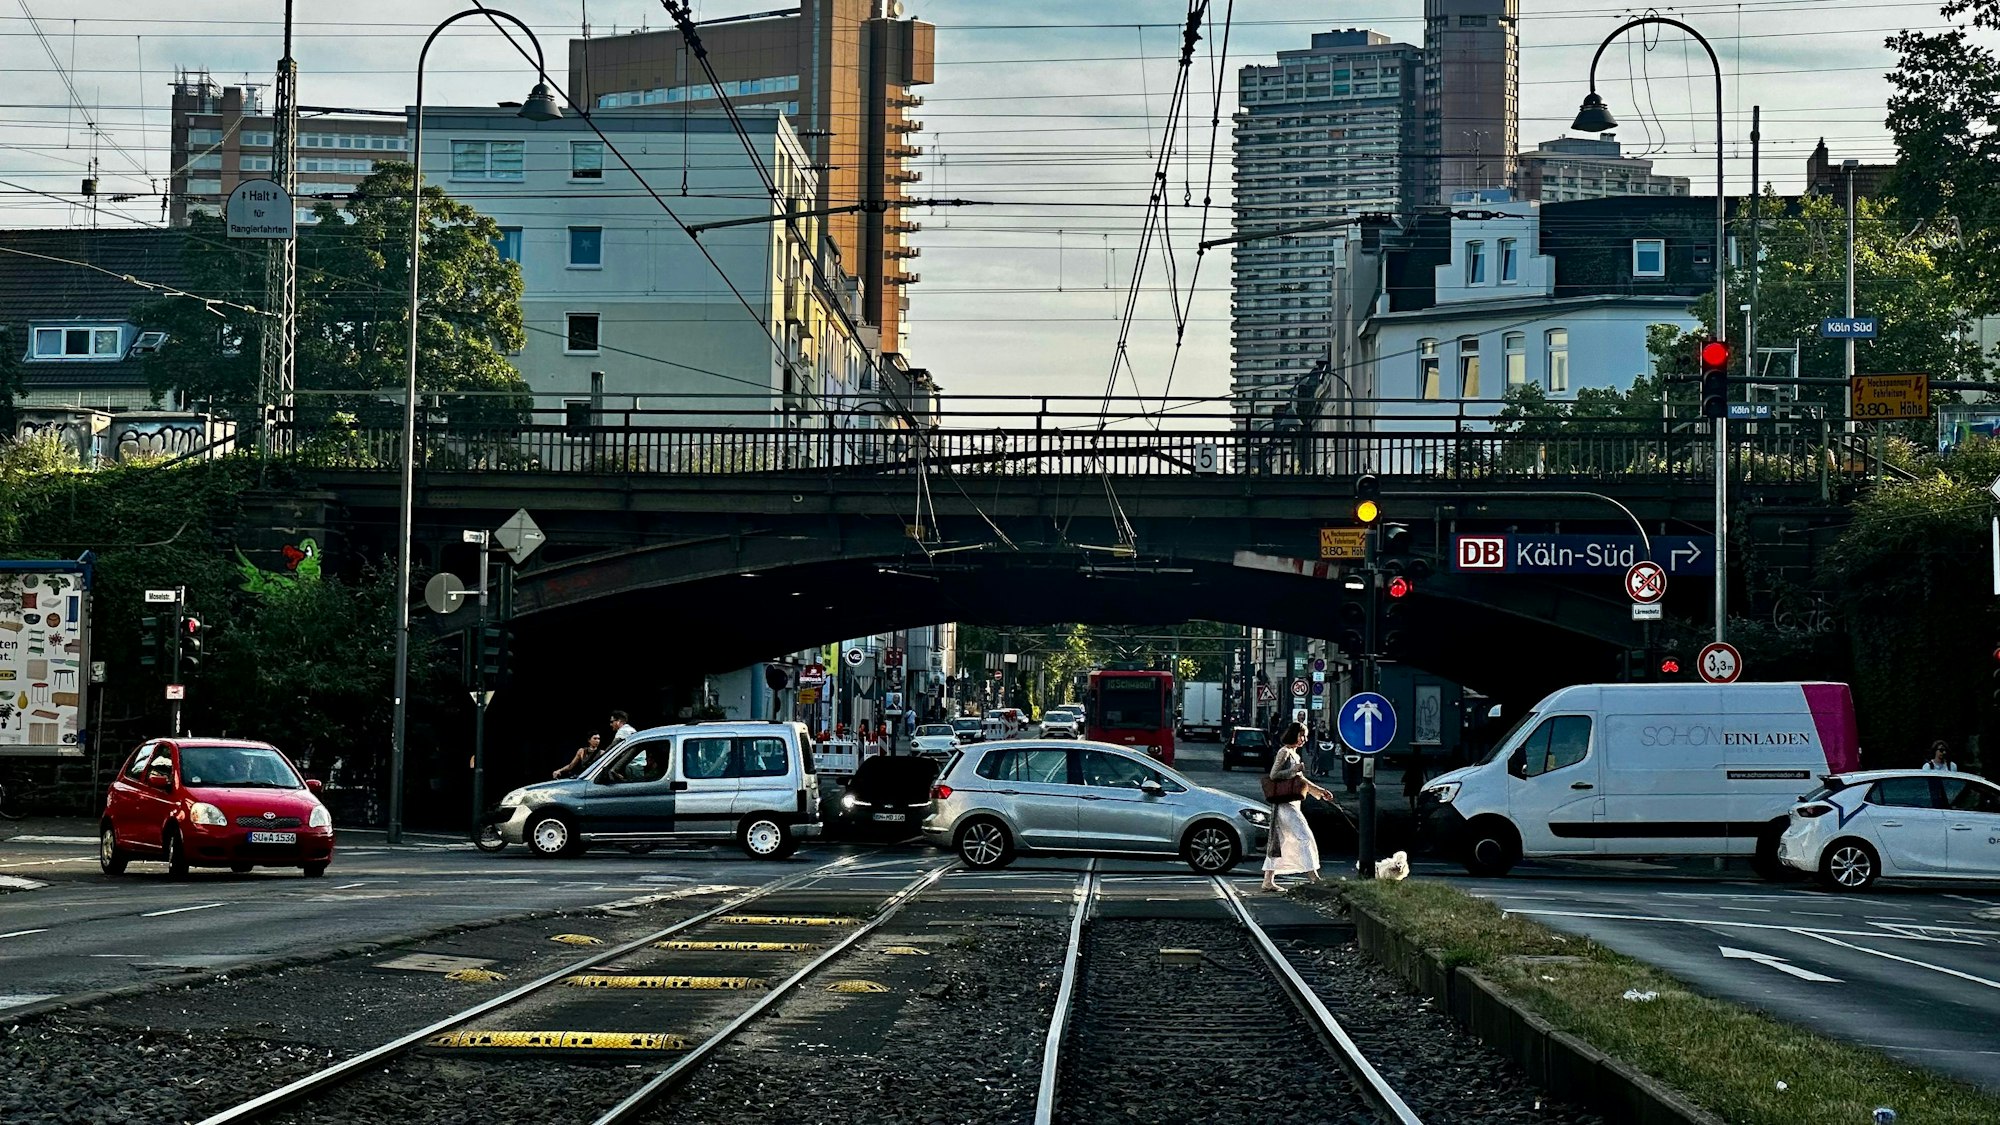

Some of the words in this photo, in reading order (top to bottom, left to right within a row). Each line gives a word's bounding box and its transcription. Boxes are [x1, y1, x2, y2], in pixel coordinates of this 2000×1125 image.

[249, 191, 270, 201] Halt
[254, 209, 265, 217] für
[231, 224, 288, 235] Rangierfahrten
[1827, 321, 1850, 332] Köln
[1853, 321, 1873, 332] Süd
[1873, 390, 1907, 399] Fahrleitung
[1731, 405, 1750, 414] Köln
[1900, 401, 1923, 415] Höhe
[1200, 447, 1212, 469] 5
[1462, 541, 1501, 565] DB
[1517, 542, 1634, 567] Köln-Süd
